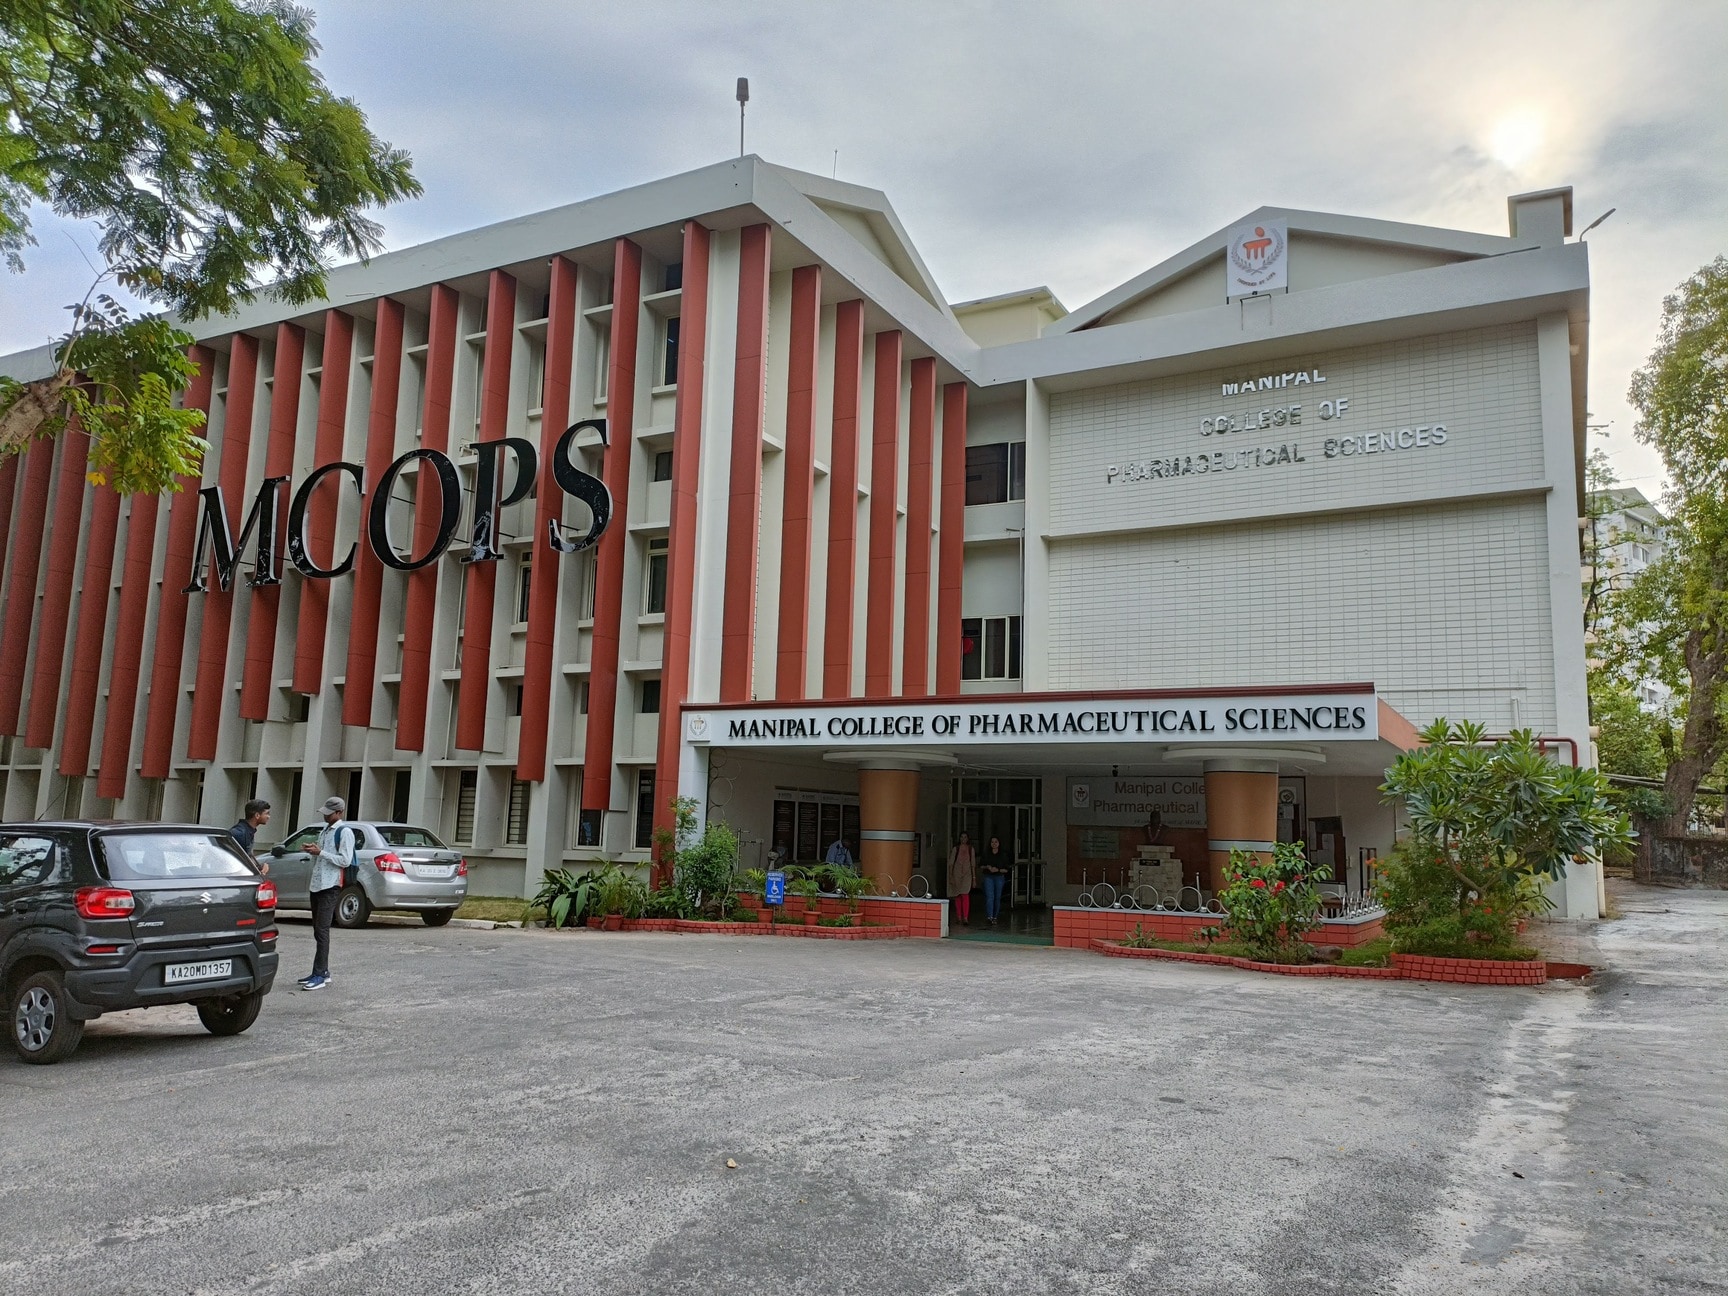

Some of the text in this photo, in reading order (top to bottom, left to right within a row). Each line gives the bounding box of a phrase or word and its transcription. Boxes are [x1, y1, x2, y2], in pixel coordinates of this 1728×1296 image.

[1222, 369, 1327, 396] MANIPAL
[1200, 398, 1349, 437] COLLEGE OF
[1107, 424, 1448, 484] PHARMACEUTICAL SCIENCES
[181, 418, 614, 594] MCOPS
[728, 706, 1367, 739] MANIPAL COLLEGE OF PHARMACEUTICAL SCIENCES
[1115, 781, 1166, 796] Manipal
[1094, 800, 1199, 814] Pharmaceutical
[171, 962, 231, 978] KA20MD1357
